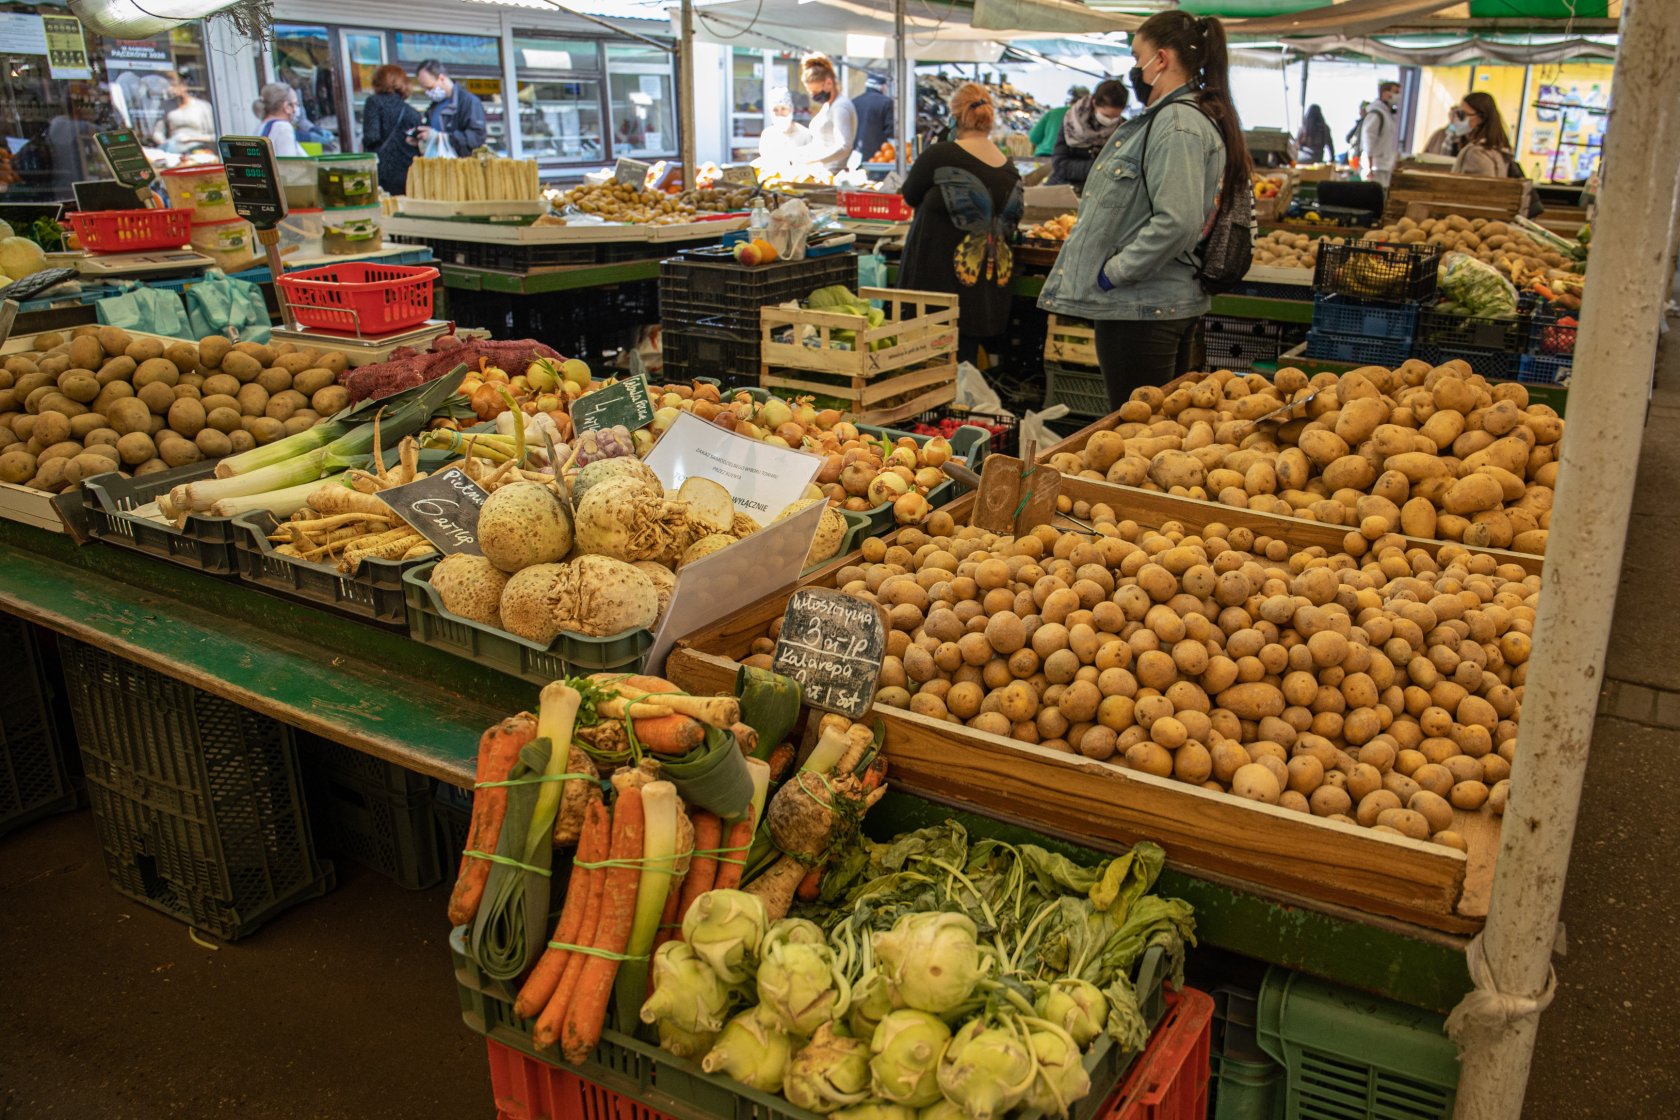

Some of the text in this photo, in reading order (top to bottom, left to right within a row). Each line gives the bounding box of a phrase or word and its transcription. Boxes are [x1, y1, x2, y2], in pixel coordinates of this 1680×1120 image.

[585, 396, 624, 416] 4
[411, 498, 460, 516] 6
[732, 496, 768, 513] WYŁĄCZNIE
[803, 617, 821, 646] 3
[779, 647, 853, 679] Kalarepa
